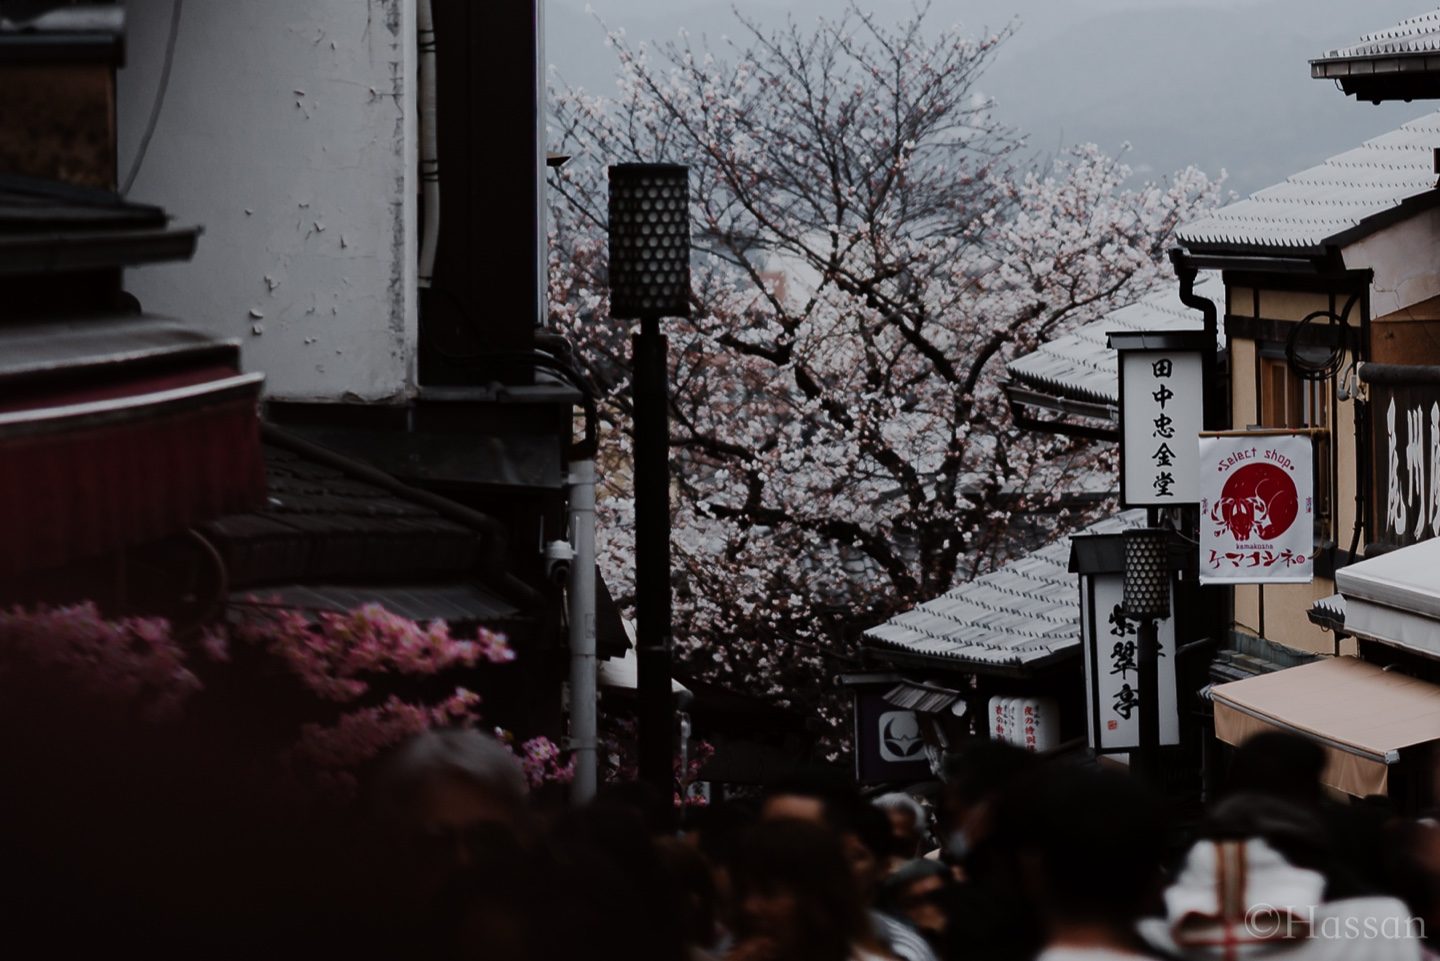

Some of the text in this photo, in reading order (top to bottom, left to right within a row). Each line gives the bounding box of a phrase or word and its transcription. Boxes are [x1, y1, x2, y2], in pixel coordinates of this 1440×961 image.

[1151, 358, 1176, 498] 田中忠金堂
[1220, 447, 1291, 471] Select shop
[1208, 548, 1298, 570] ケマコシネ
